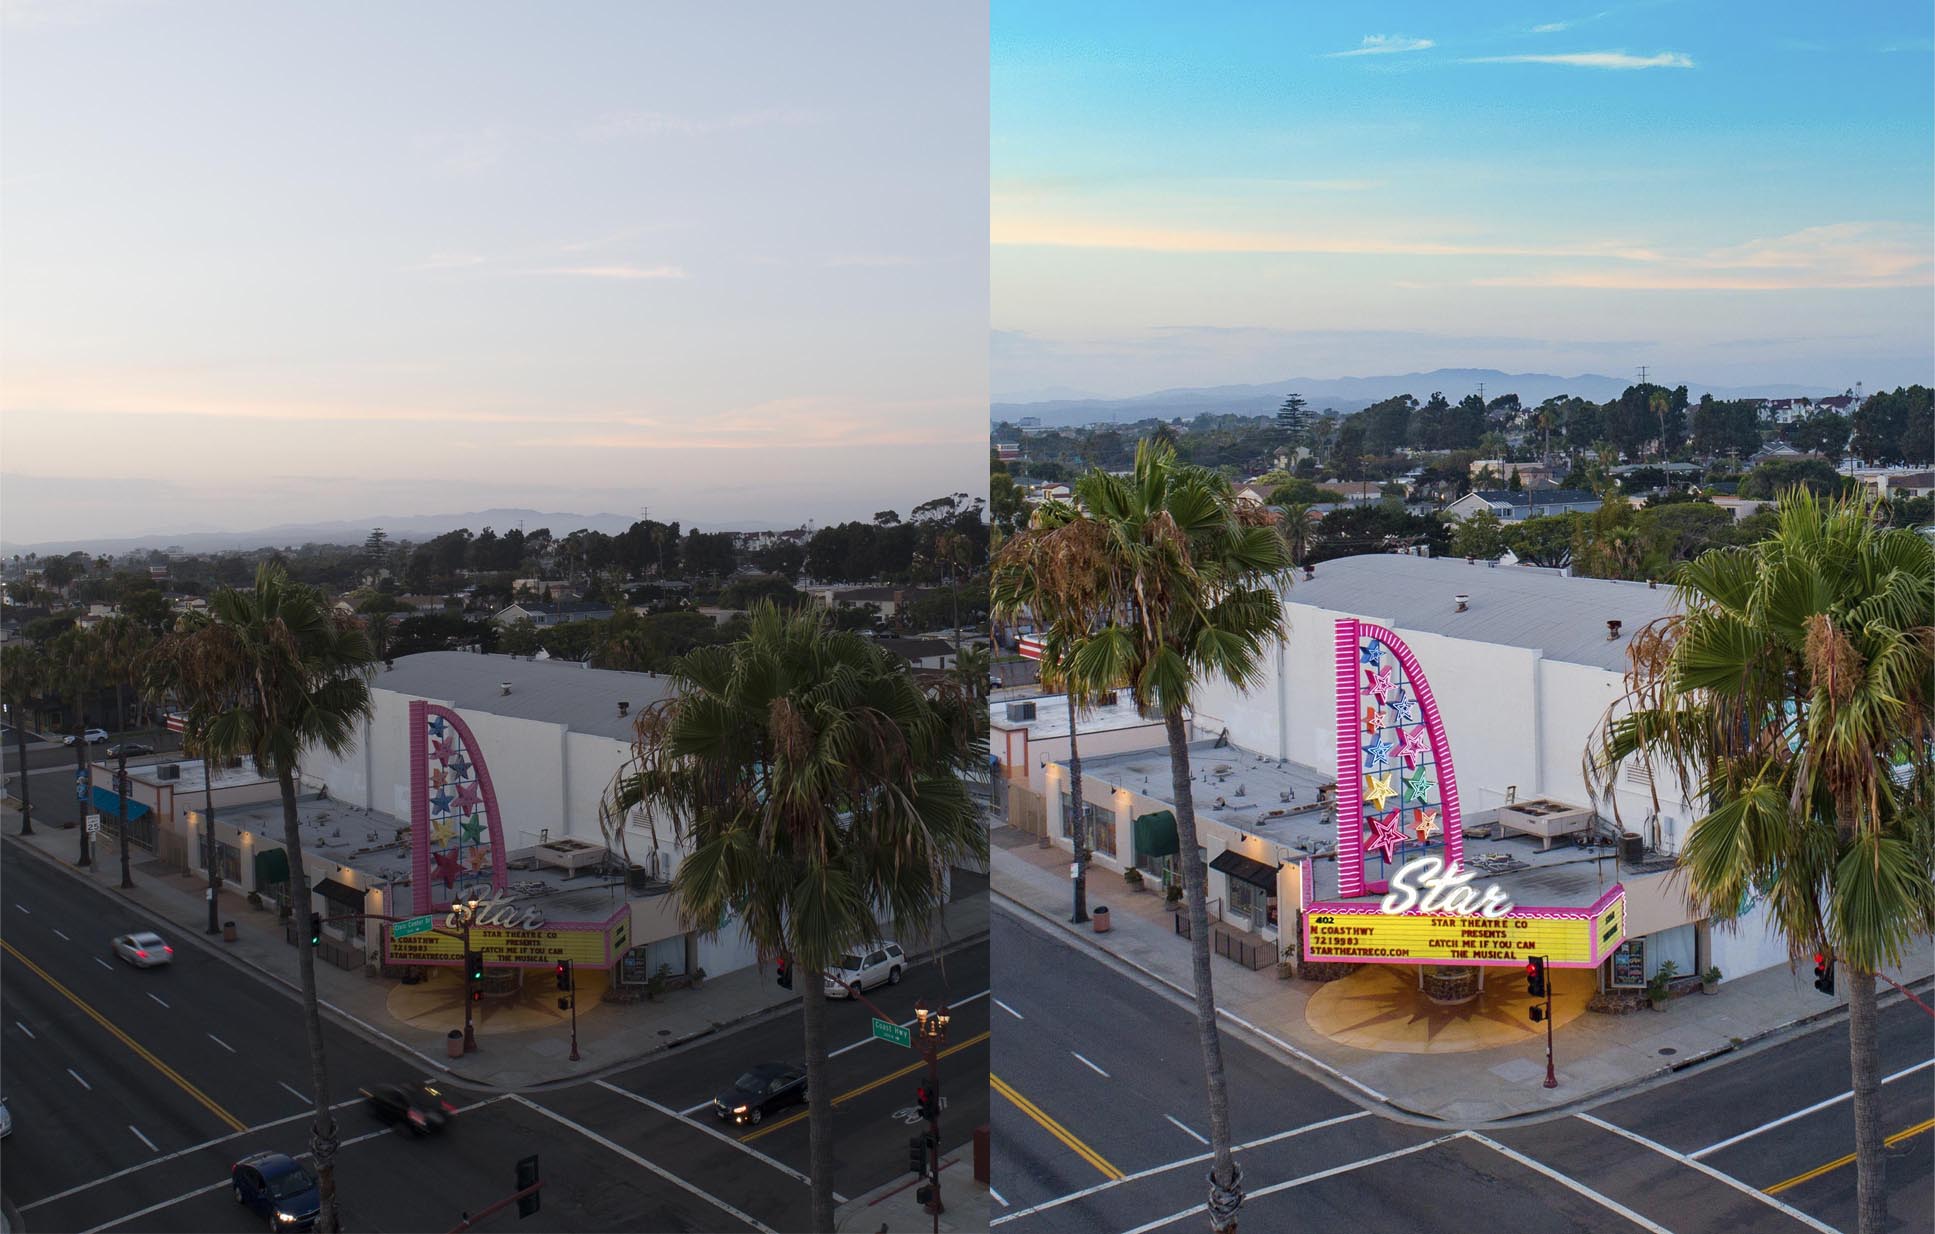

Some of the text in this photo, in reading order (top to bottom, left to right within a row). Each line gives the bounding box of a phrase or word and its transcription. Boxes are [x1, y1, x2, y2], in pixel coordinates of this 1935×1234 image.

[87, 823, 99, 831] 25
[1381, 856, 1514, 918] Star
[445, 883, 544, 930] Star
[1431, 918, 1528, 929] STAR THEATRE CO
[1461, 929, 1507, 938] PRESENTS
[1428, 939, 1536, 950] CATCH ME IF YOU CAN
[1310, 946, 1409, 957] STARTHEATRECO.COM
[1450, 949, 1517, 960] THE MUSICAL
[875, 1021, 891, 1032] Coast
[894, 1027, 907, 1038] Hwy
